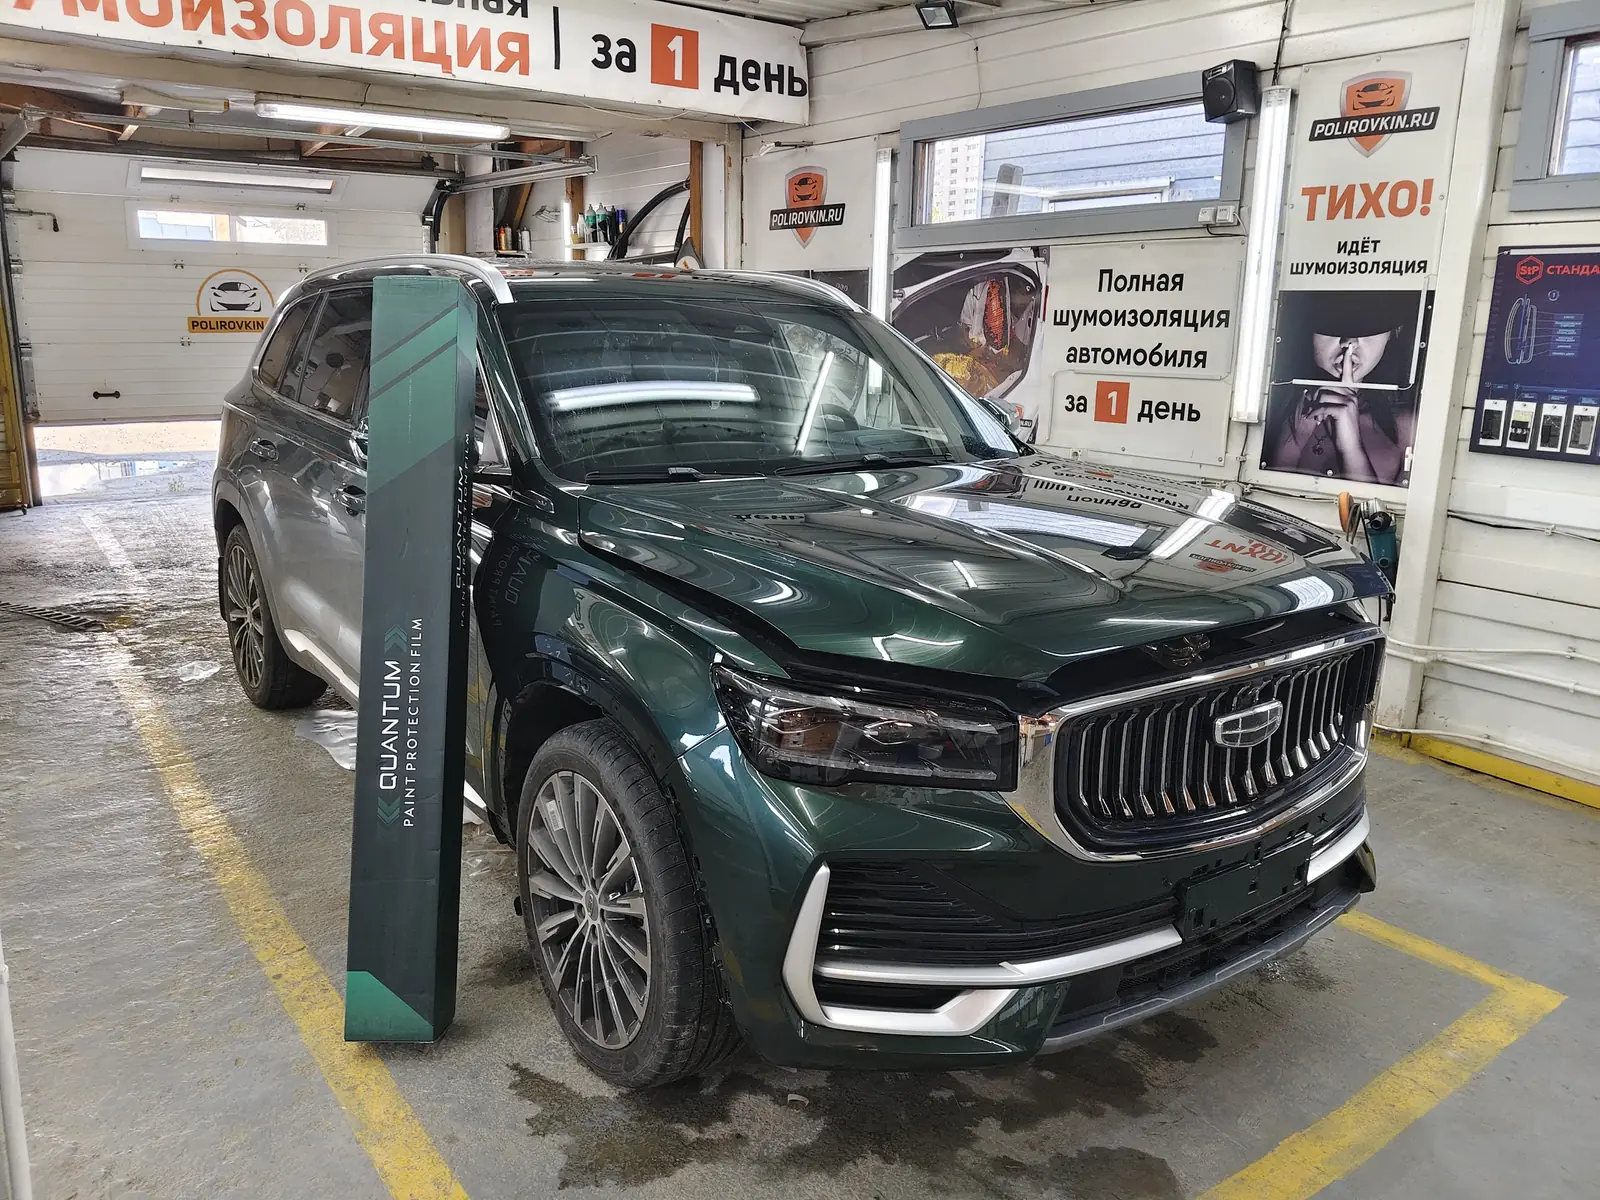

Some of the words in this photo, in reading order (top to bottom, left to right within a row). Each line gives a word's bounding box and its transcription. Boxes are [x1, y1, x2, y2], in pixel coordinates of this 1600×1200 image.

[13, 0, 530, 76] ОИЗОЛЯЦИЯ
[591, 33, 637, 73] за
[667, 35, 682, 81] 1
[714, 54, 808, 98] день
[1314, 111, 1435, 138] POLIROVKIN.RU
[1301, 178, 1435, 222] ТИХО!
[771, 208, 843, 227] POLIROVKIN.RU
[1337, 236, 1381, 256] ИДЁТ
[1097, 268, 1184, 293] Полная
[1290, 260, 1428, 276] ШУМОИЗОЛЯЦИЯ
[1053, 309, 1231, 333] шумоизоляция
[1065, 342, 1208, 369] автомобиля
[1064, 394, 1088, 413] за
[1107, 390, 1118, 416] 1
[1137, 399, 1201, 424] день
[410, 618, 423, 657] FILM
[379, 660, 402, 790] QUANTUM
[405, 662, 421, 771] PROTECTION
[403, 776, 417, 827] PAINT
